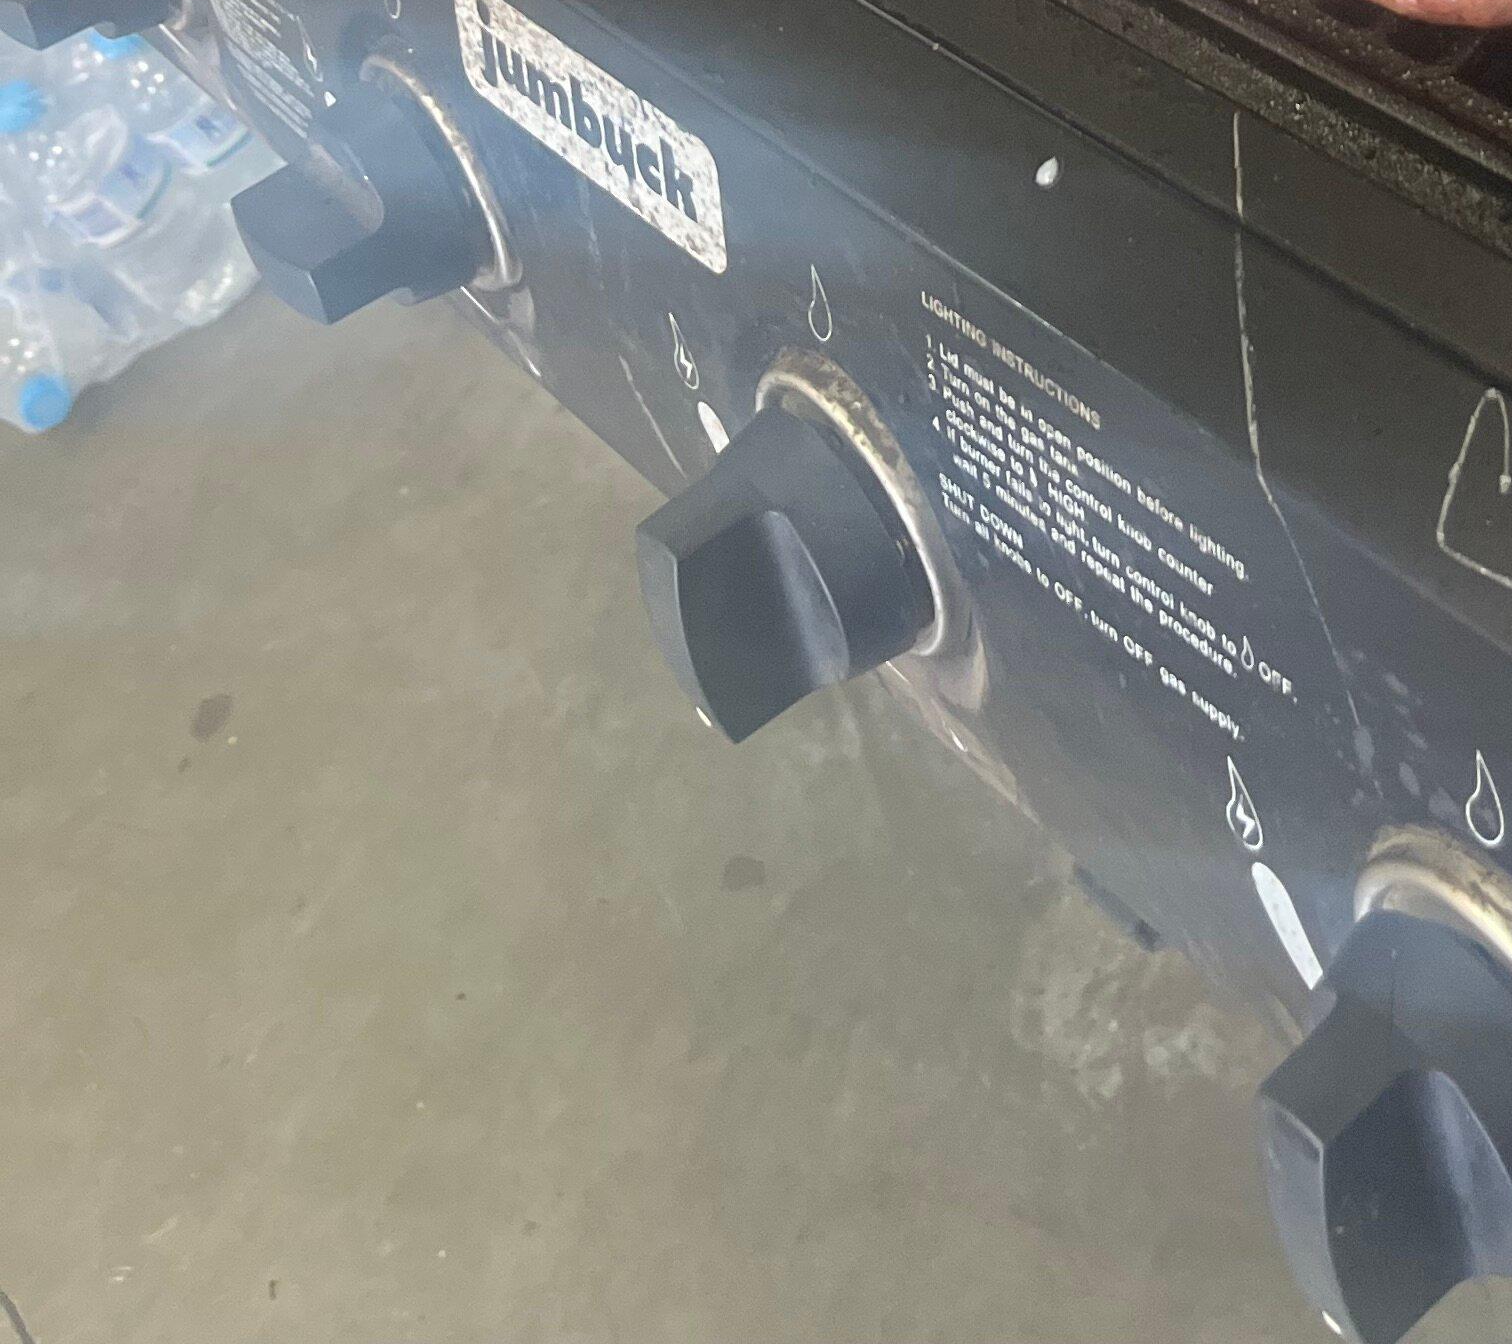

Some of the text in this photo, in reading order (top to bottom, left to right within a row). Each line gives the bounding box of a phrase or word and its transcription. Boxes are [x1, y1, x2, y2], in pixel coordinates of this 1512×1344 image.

[921, 290, 1101, 430] LIGHTING INSTRUCTIONS
[939, 342, 960, 369] Lid
[963, 363, 995, 394] must
[998, 385, 1016, 410] be
[1038, 418, 1071, 450] open
[1075, 446, 1132, 495] position
[1137, 485, 1184, 531] before
[941, 362, 970, 396] Turn
[974, 391, 991, 412] on
[995, 404, 1016, 431] the
[1020, 426, 1045, 451] gas
[938, 472, 1024, 550] SHUT DOWN
[942, 385, 975, 420] Push
[979, 415, 1004, 442] and
[1007, 433, 1034, 463] turn
[1065, 478, 1112, 523] control
[1117, 513, 1152, 551] knob
[1157, 547, 1214, 597] counter
[945, 409, 1006, 462] clockwise
[1010, 455, 1024, 476] to
[941, 491, 971, 524] Turn
[992, 532, 1033, 574] knobs
[1036, 567, 1050, 588] to
[1090, 609, 1119, 642] turn
[1122, 635, 1153, 666] OFF
[1159, 666, 1187, 696] gas
[952, 454, 979, 480] wait
[982, 471, 992, 489] 5
[995, 485, 1047, 534] minutes
[1051, 527, 1077, 555] and
[1080, 549, 1126, 593] repeat
[1129, 584, 1154, 614] the
[959, 435, 1001, 477] burner
[1005, 470, 1034, 502] fails
[1092, 536, 1120, 569] turn
[1125, 565, 1175, 610] control
[1179, 601, 1216, 641] knob
[1221, 633, 1237, 657] to
